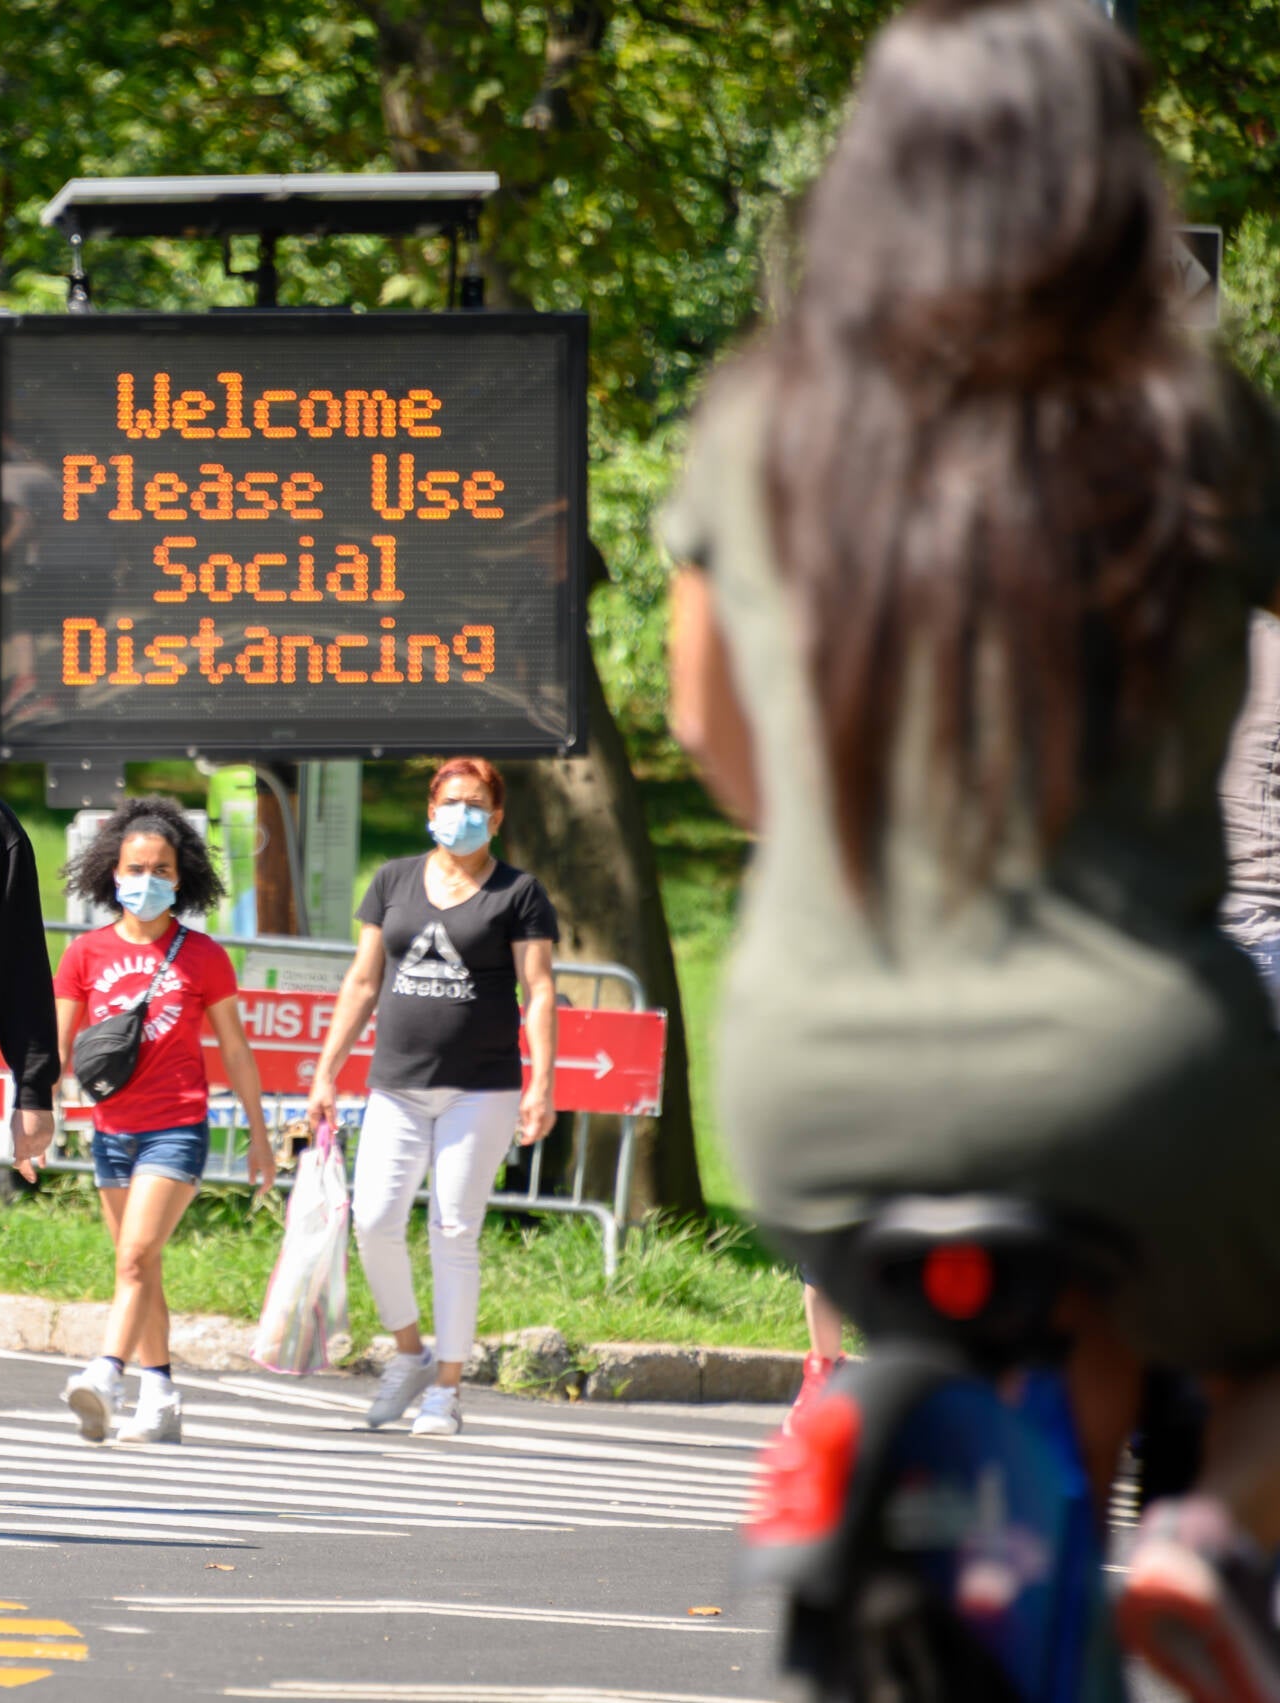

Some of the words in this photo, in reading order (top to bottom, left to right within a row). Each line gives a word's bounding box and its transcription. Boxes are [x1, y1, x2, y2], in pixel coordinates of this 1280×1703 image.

[118, 373, 441, 438] Welcome
[65, 456, 322, 520] Please
[372, 454, 503, 520] Use
[155, 535, 403, 602] Social
[64, 618, 493, 685] Distancing
[392, 974, 477, 999] Reebok
[237, 1001, 302, 1038] HIS
